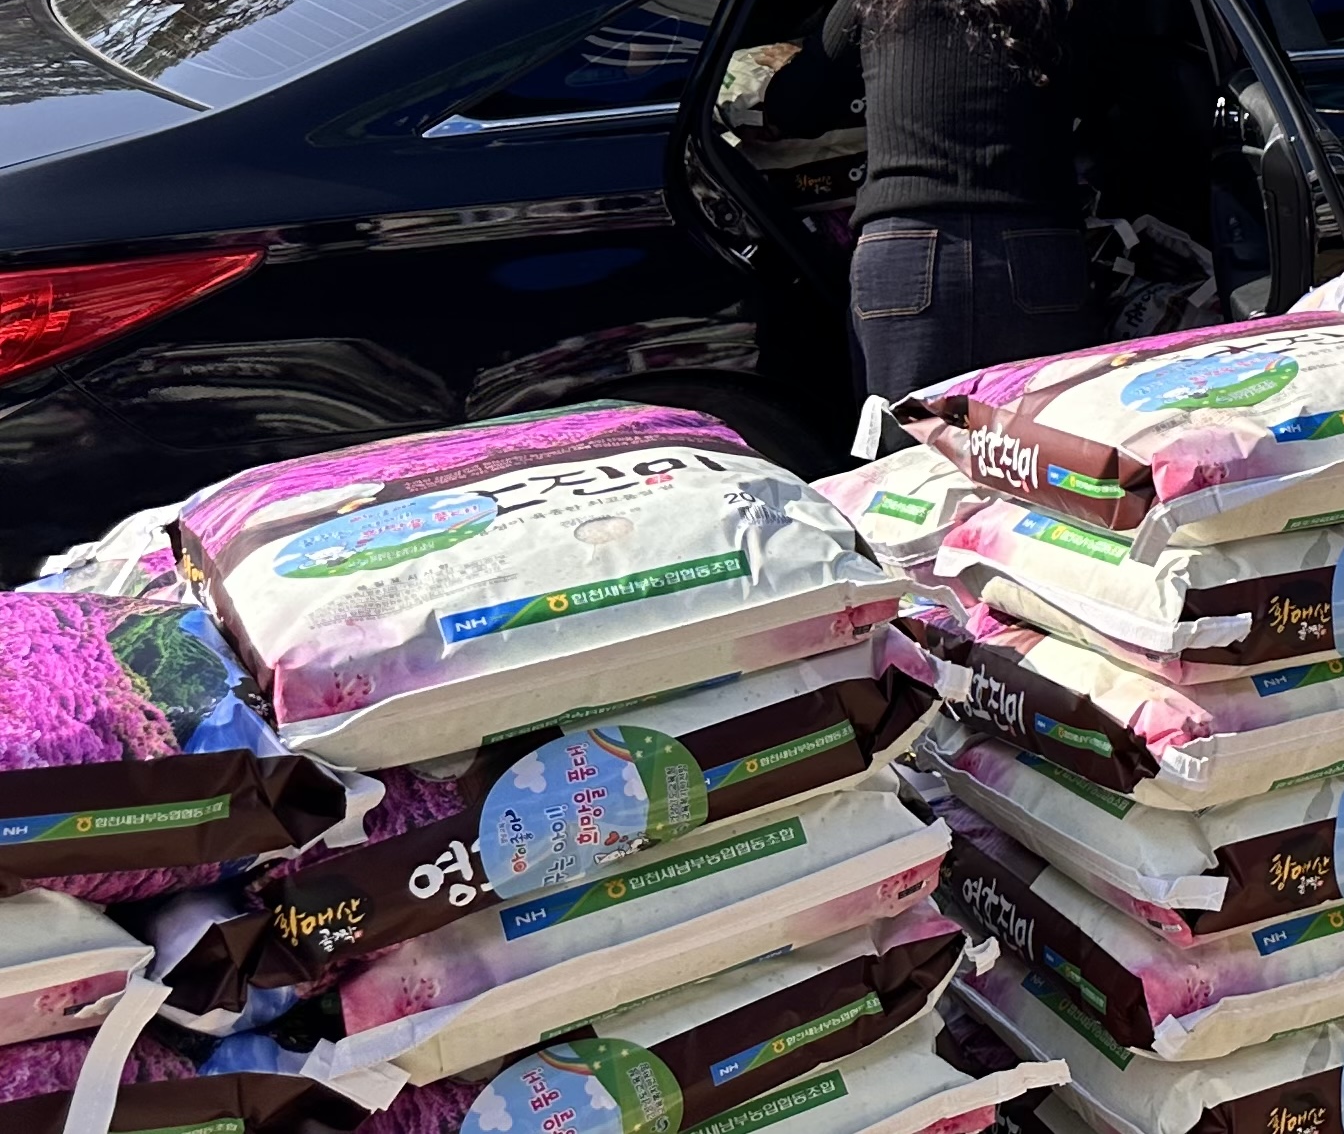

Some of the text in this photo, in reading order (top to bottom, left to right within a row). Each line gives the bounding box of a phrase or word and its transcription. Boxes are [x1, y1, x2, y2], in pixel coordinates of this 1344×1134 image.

[1279, 423, 1302, 435] NH
[971, 422, 1039, 490] 영호진미
[571, 558, 741, 605] 합천새남부농업협동조합
[455, 616, 488, 631] NH
[1270, 596, 1332, 629] 황매산
[1263, 674, 1288, 689] NH
[2, 825, 28, 837] NH
[575, 786, 608, 846] 희망을
[504, 808, 535, 874] 아이좋아
[628, 827, 795, 890] 합천새남부농업협동조합
[1269, 853, 1331, 891] 황매산
[274, 897, 366, 947] 황매산
[515, 907, 547, 927] NH
[962, 876, 1036, 962] 영호진미
[1262, 931, 1288, 946] NH
[719, 1061, 739, 1078] NH
